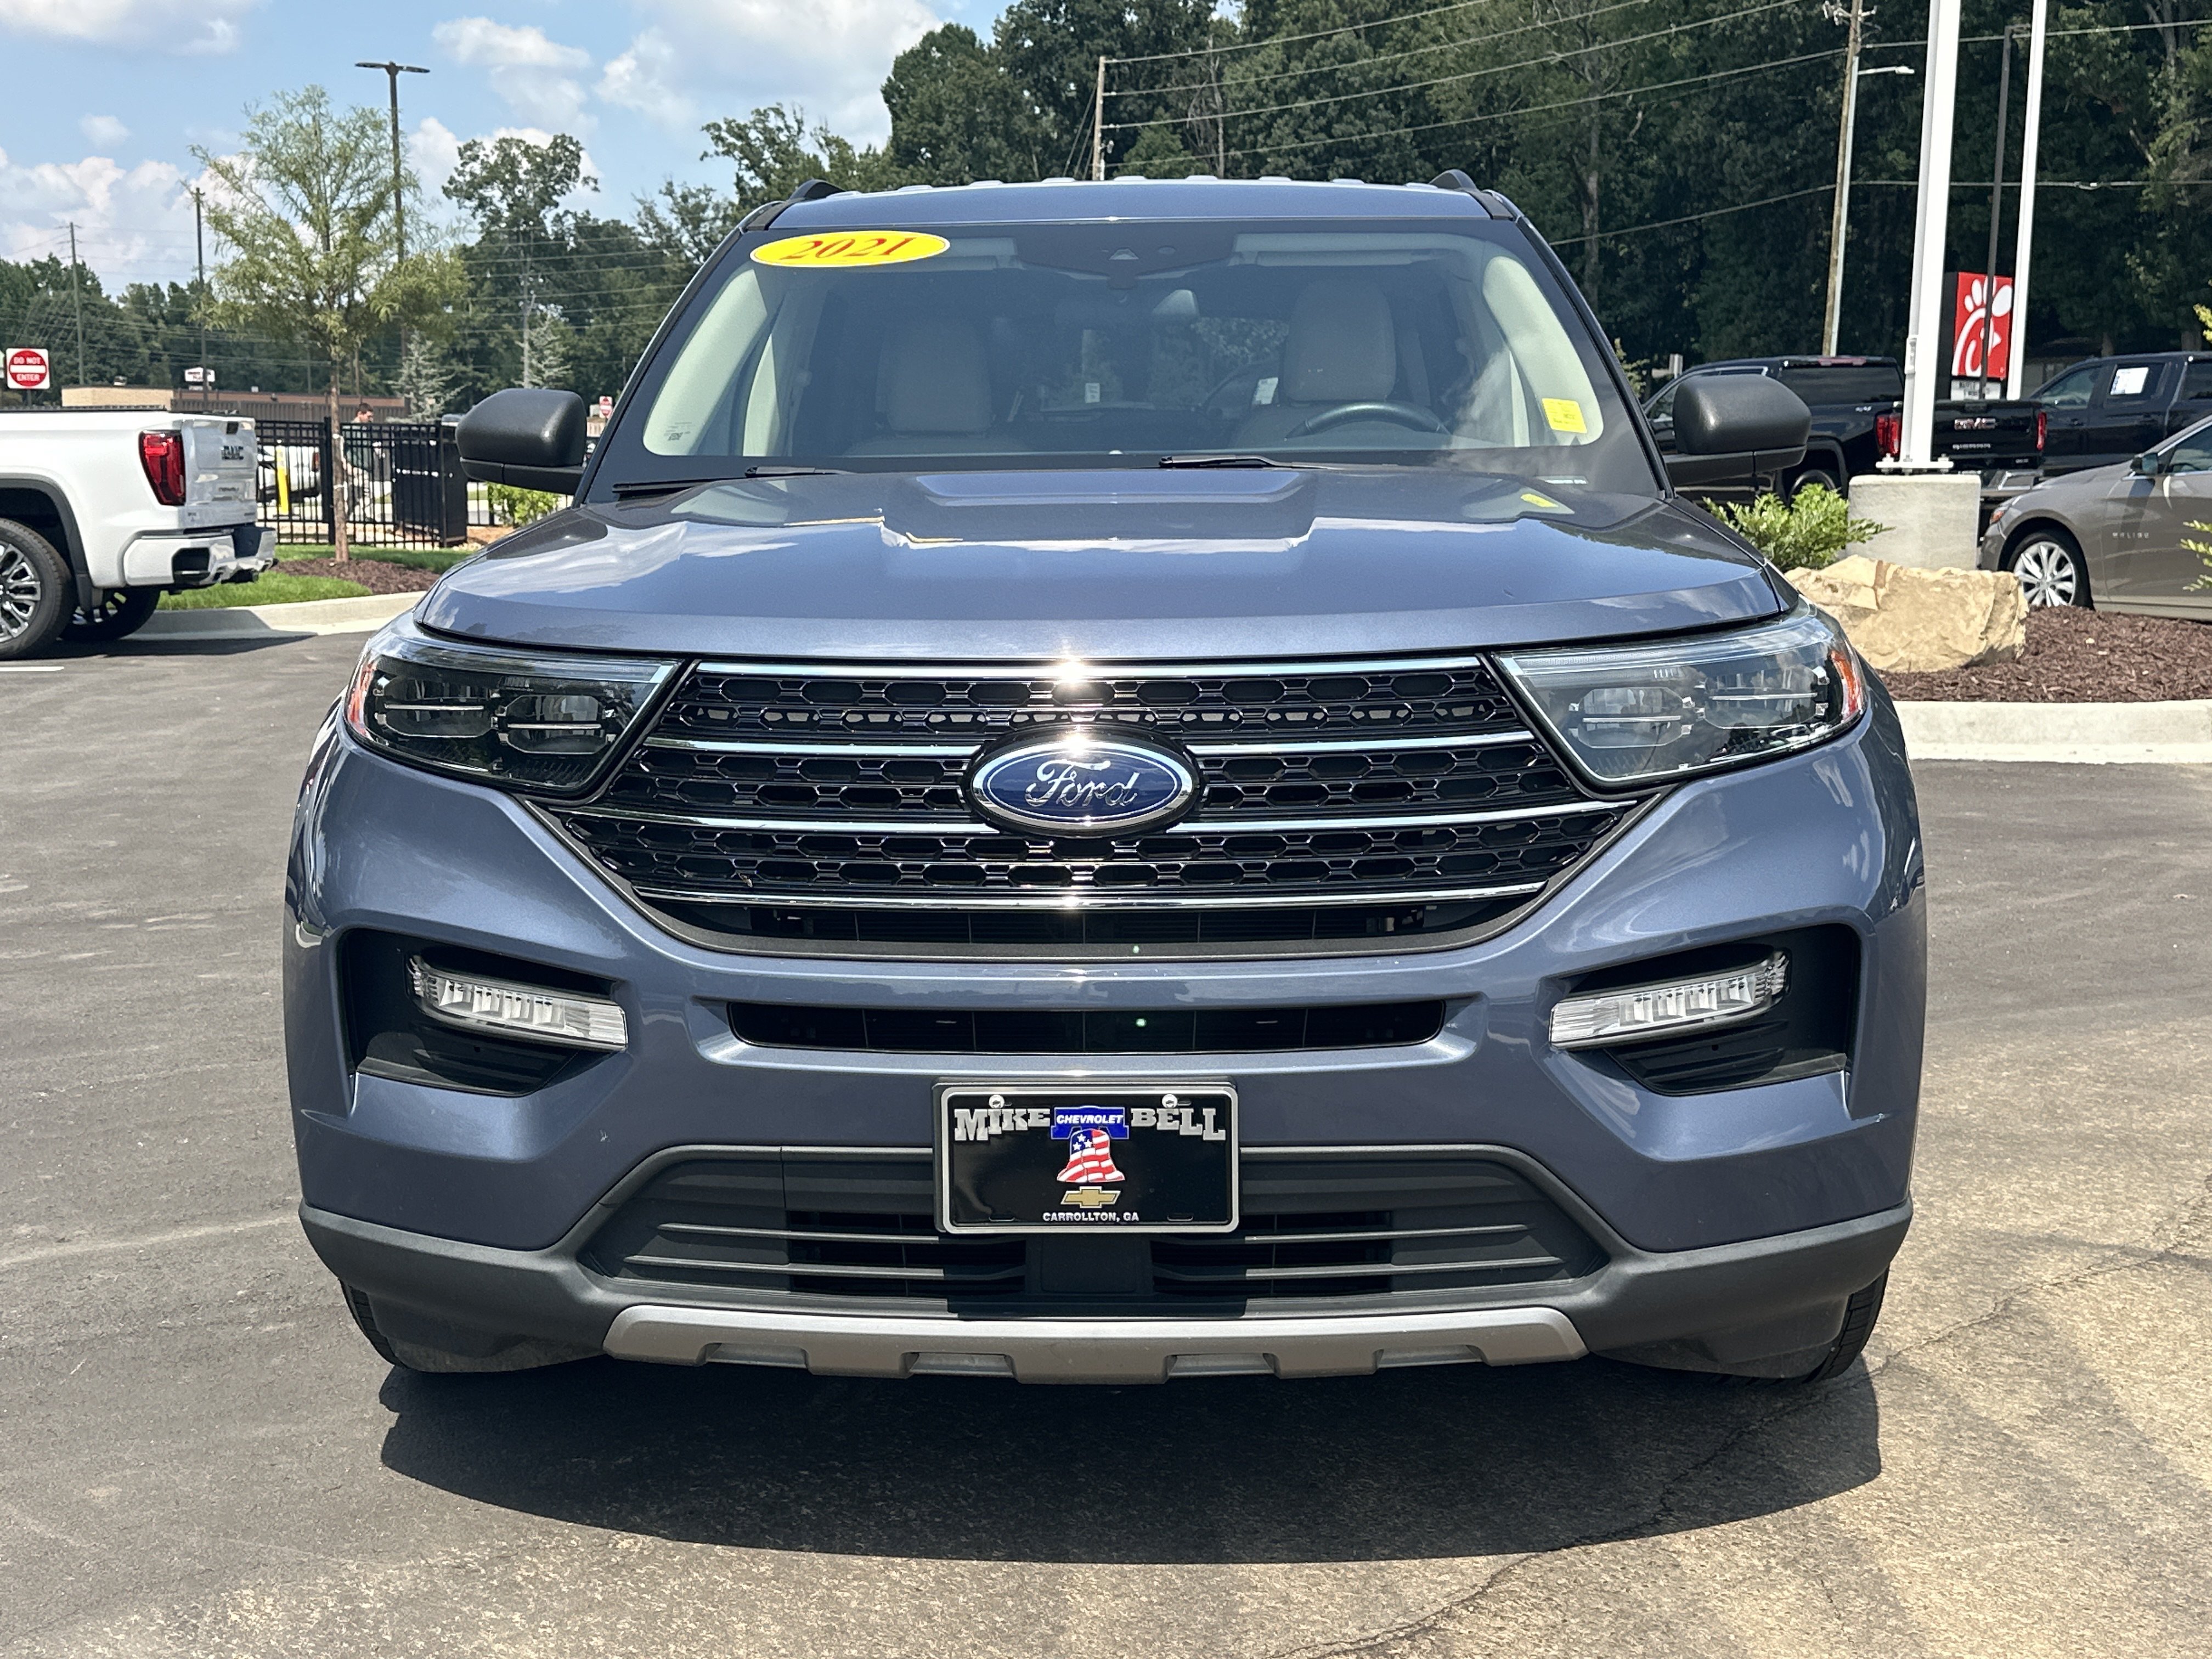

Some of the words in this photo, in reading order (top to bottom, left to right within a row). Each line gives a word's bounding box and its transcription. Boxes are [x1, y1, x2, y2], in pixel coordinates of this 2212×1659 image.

[779, 238, 916, 260] 2021
[13, 356, 25, 365] DO
[26, 356, 41, 365] NOT
[16, 373, 40, 382] ENTER
[1954, 417, 1996, 431] GMC
[1025, 759, 1140, 808] Ford
[954, 1108, 1051, 1141] MIKE
[1056, 1114, 1125, 1125] CHEVROLET
[1131, 1108, 1226, 1141] BELL
[1042, 1212, 1120, 1222] CARROLLTON,
[1122, 1212, 1139, 1222] GA
